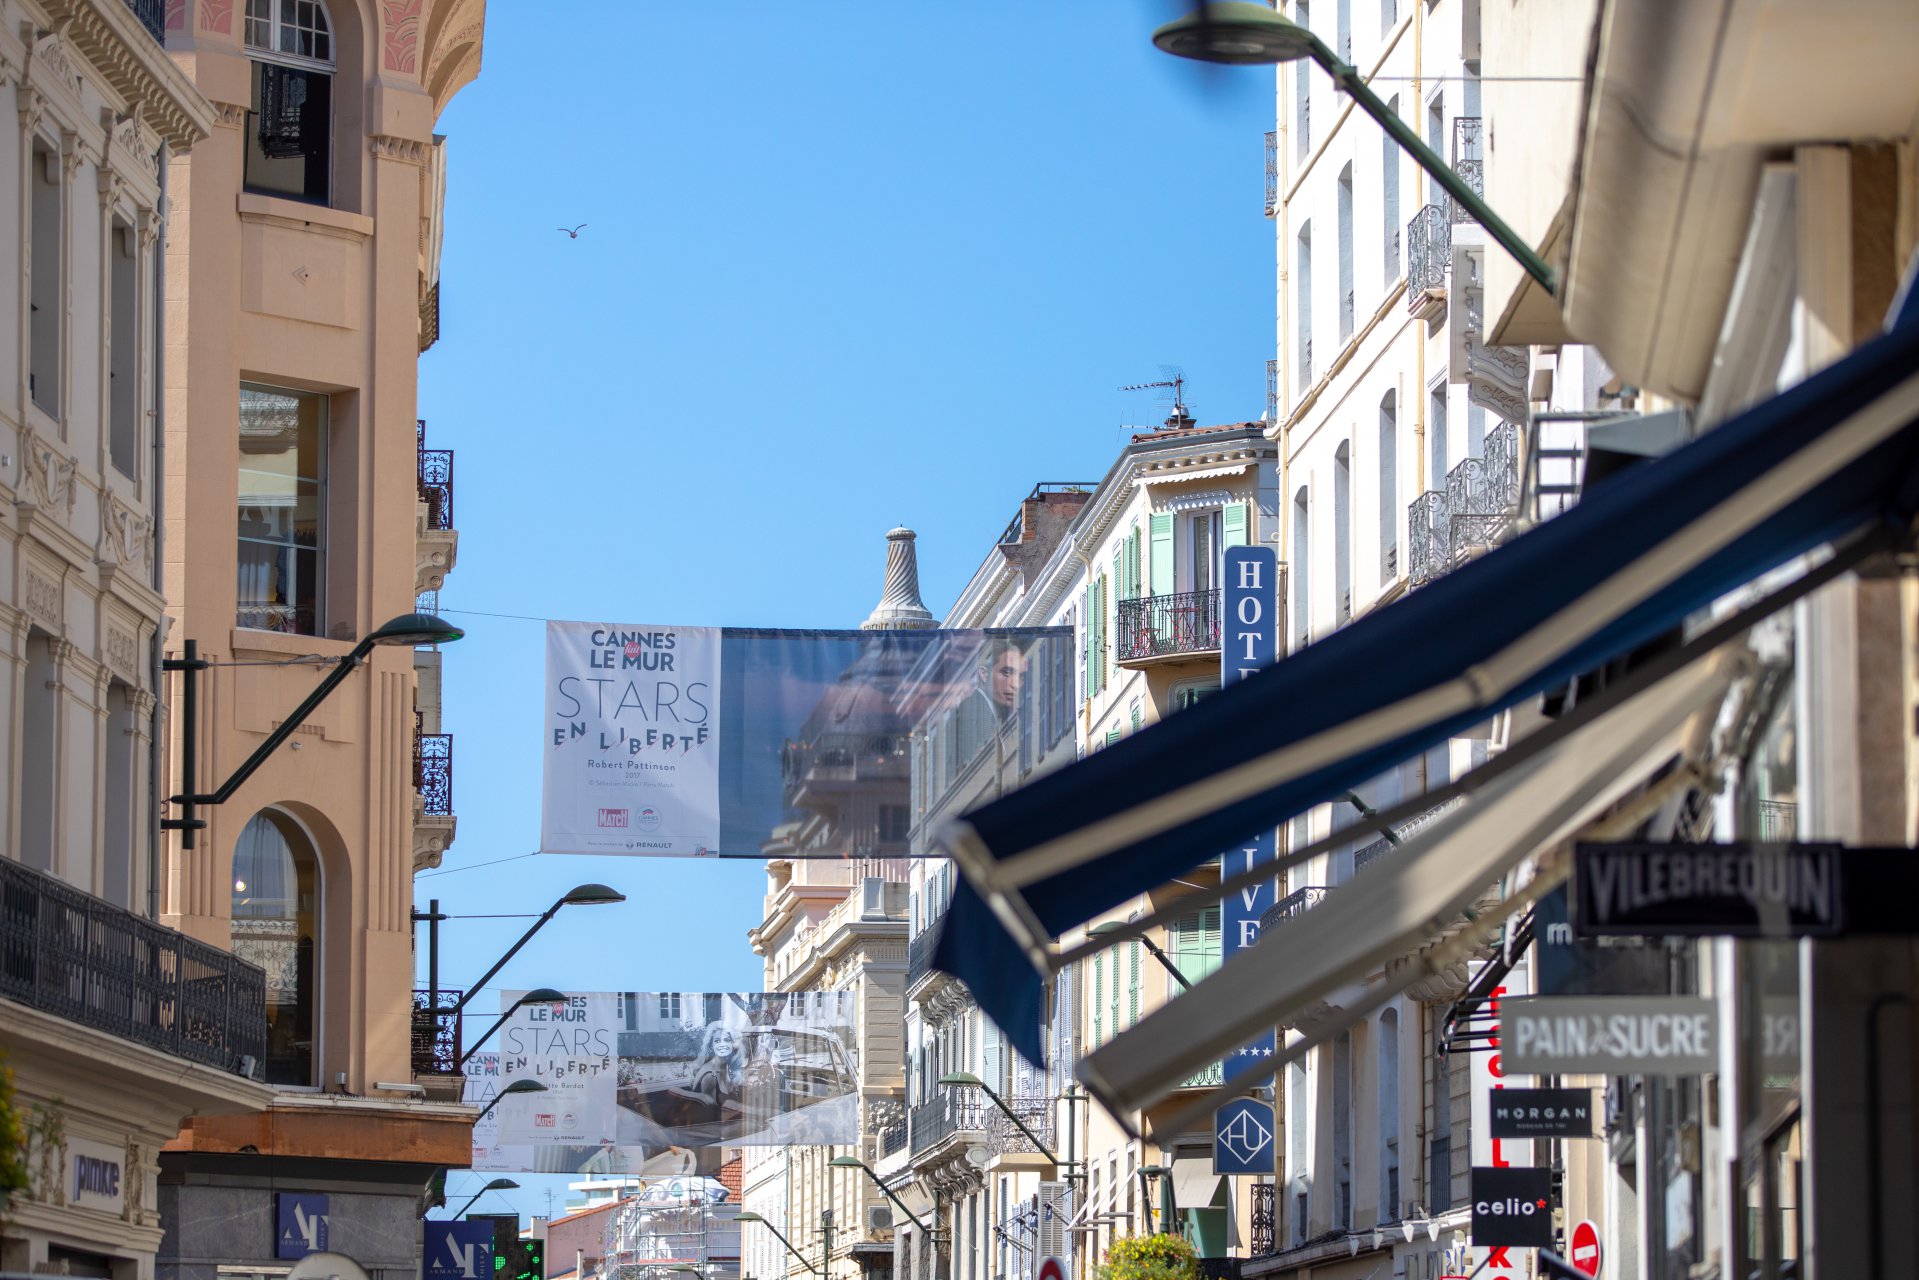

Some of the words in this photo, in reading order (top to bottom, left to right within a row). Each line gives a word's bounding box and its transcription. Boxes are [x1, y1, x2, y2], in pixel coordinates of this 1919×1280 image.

[1237, 561, 1263, 680] HOT
[591, 630, 676, 649] CANNES
[590, 650, 616, 669] LE
[622, 652, 675, 671] MUR
[556, 676, 709, 724] STARS
[554, 722, 586, 746] EN
[600, 723, 709, 755] LIBERTÉ
[588, 760, 623, 769] Robert
[627, 761, 676, 771] Pattinson
[599, 809, 629, 827] MATCH
[1588, 853, 1831, 923] VILEBREQUIN
[530, 1009, 548, 1022] LE
[552, 1009, 587, 1022] MUR
[507, 1027, 610, 1057] STARS
[1516, 1015, 1588, 1058] PAIN
[1607, 1013, 1710, 1059] SUCRE
[467, 1066, 482, 1076] LE
[469, 1055, 500, 1066] CANN
[505, 1057, 528, 1073] EN
[536, 1056, 610, 1079] LIBERTÉ
[1496, 1107, 1586, 1119] MORGAN
[73, 1154, 120, 1203] pimkie
